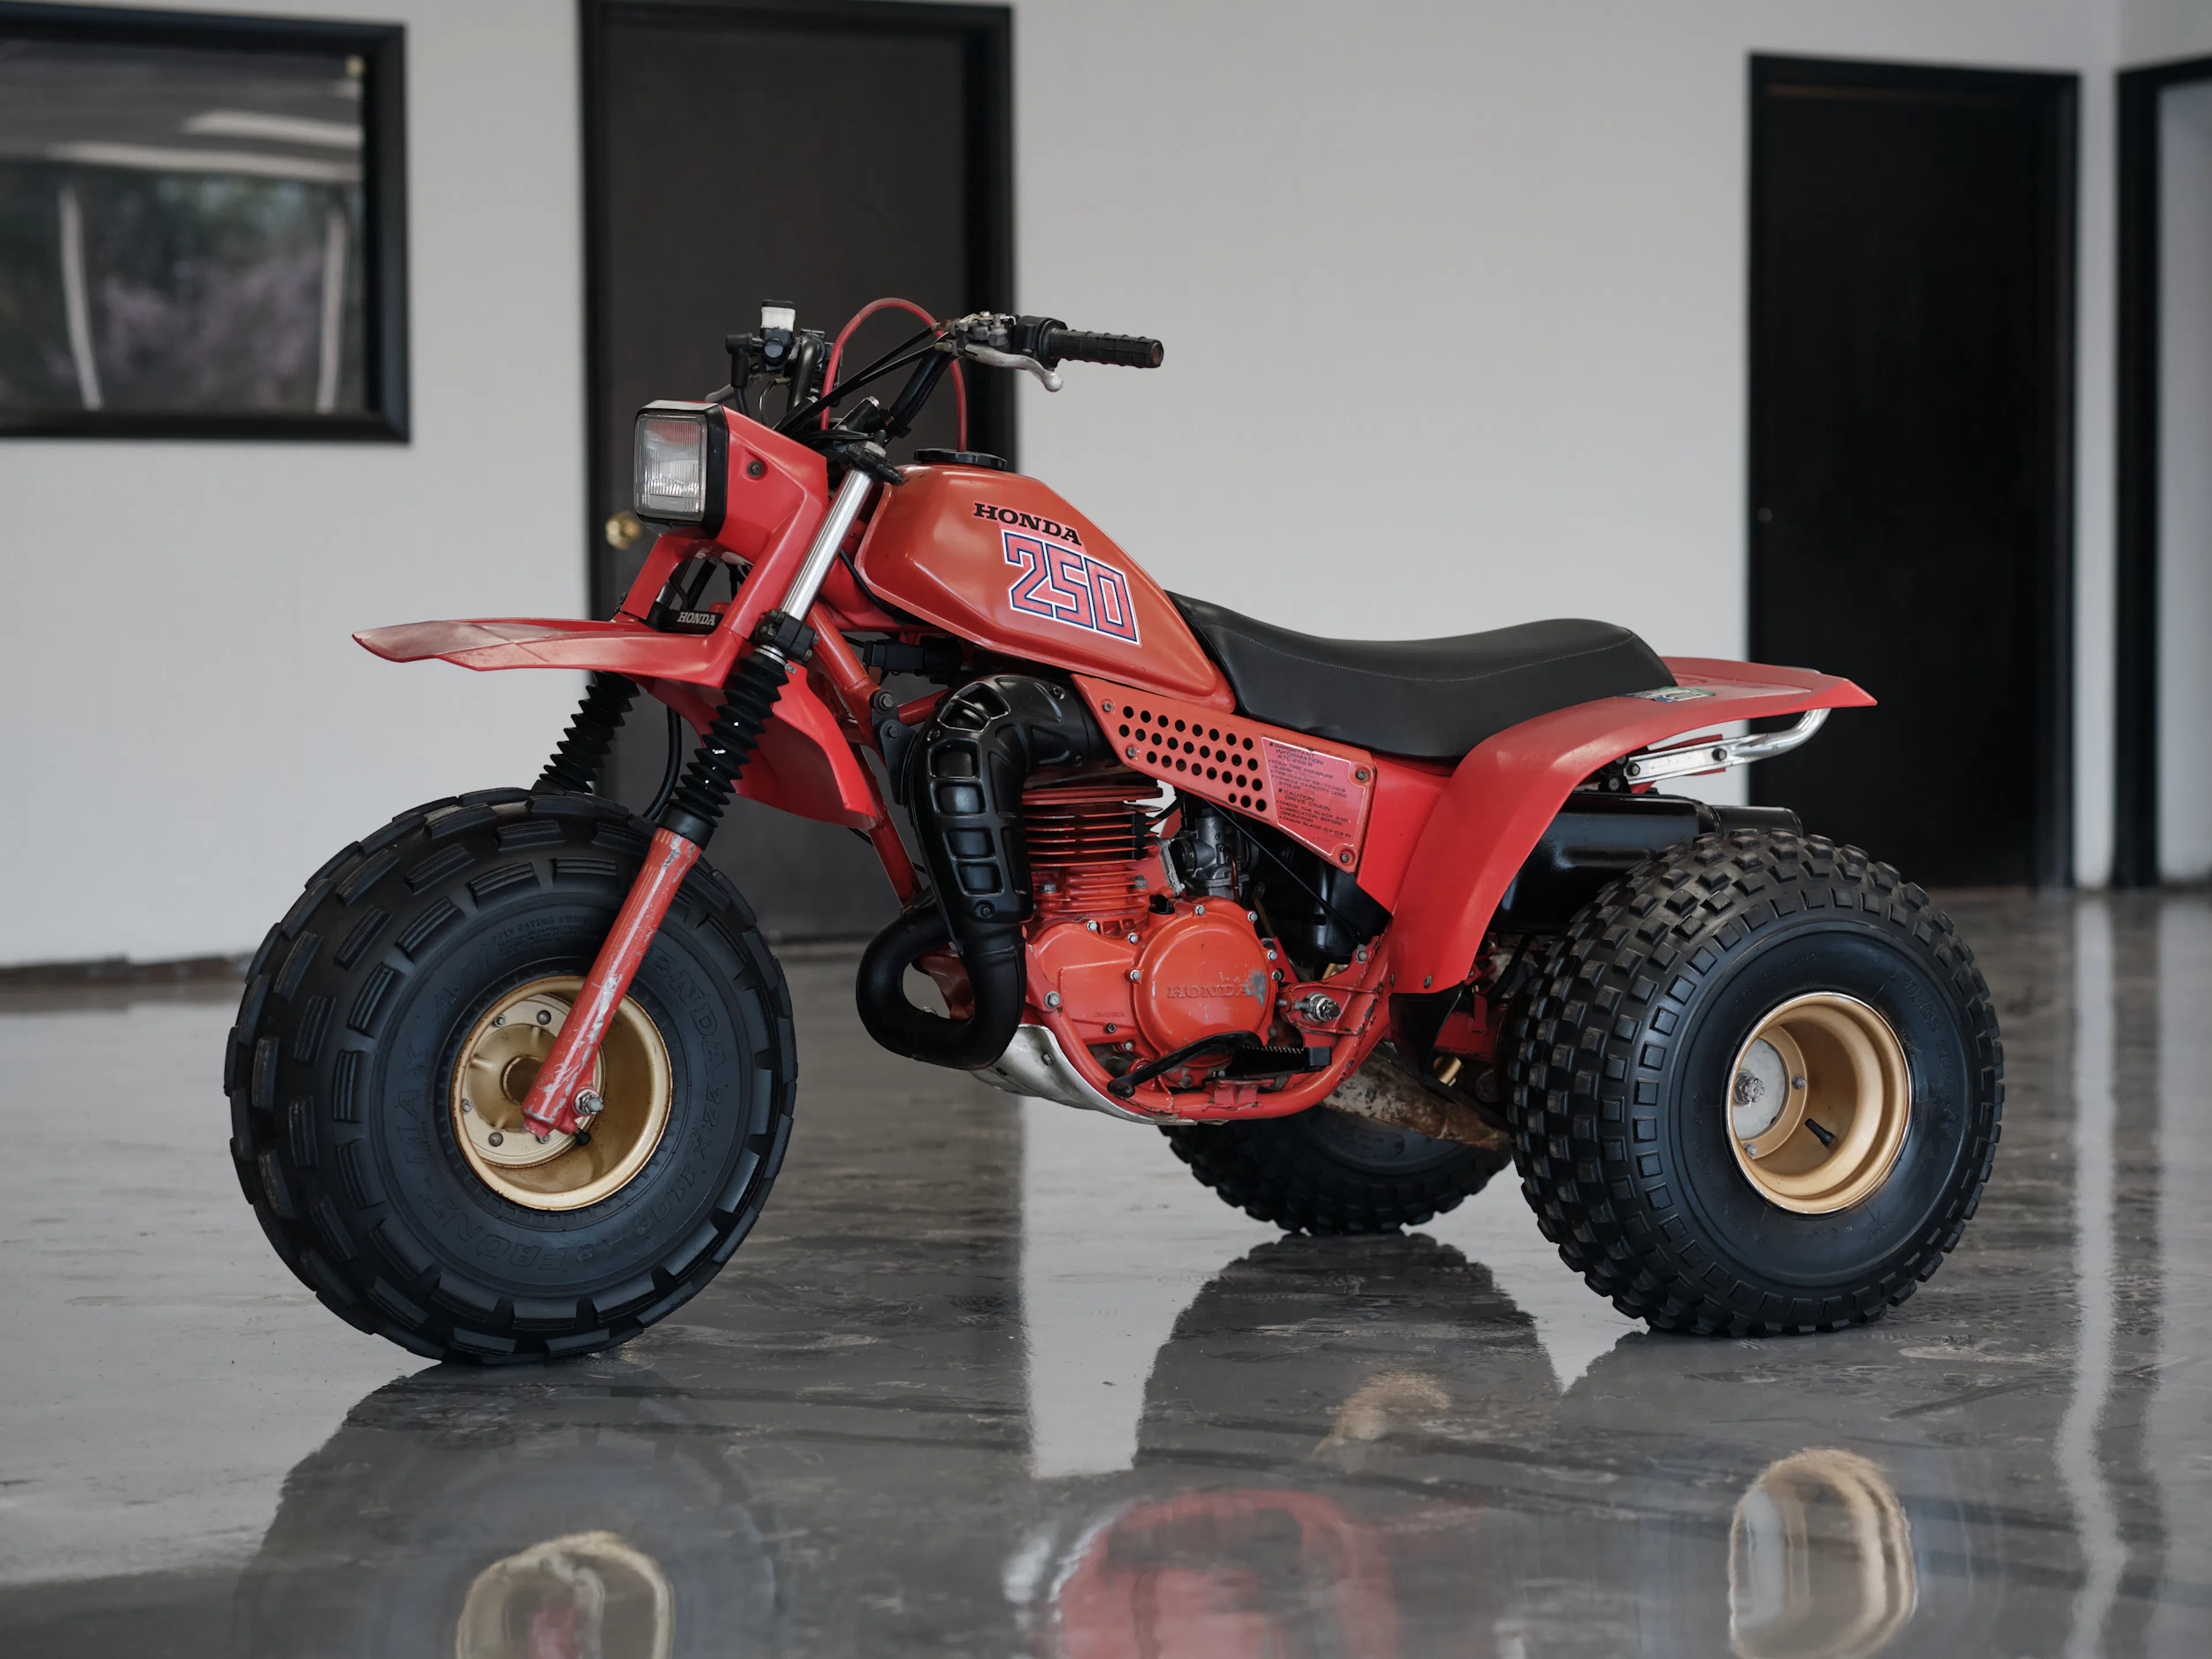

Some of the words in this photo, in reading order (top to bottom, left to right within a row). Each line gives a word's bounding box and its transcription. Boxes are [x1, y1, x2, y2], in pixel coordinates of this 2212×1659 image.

[974, 502, 1082, 546] HONDA
[1001, 529, 1141, 647] 250
[677, 612, 716, 626] HONDA
[1274, 744, 1315, 757] IMPORTANT
[1275, 749, 1323, 765] INFORMATION
[1275, 775, 1298, 785] VEHICLE
[1301, 782, 1329, 793] CAPACITY
[1283, 790, 1315, 801] CAUTION
[1285, 795, 1305, 804] DRIVE
[1308, 802, 1331, 811] CHAIN
[1280, 806, 1318, 819] LUBRICATION
[1320, 817, 1343, 825] BEFORE
[1281, 811, 1313, 823] OPERATION
[1282, 816, 1301, 824] CHAIN
[517, 916, 555, 932] RATING
[1166, 984, 1254, 998] HONDA
[642, 945, 726, 1077] ENDA
